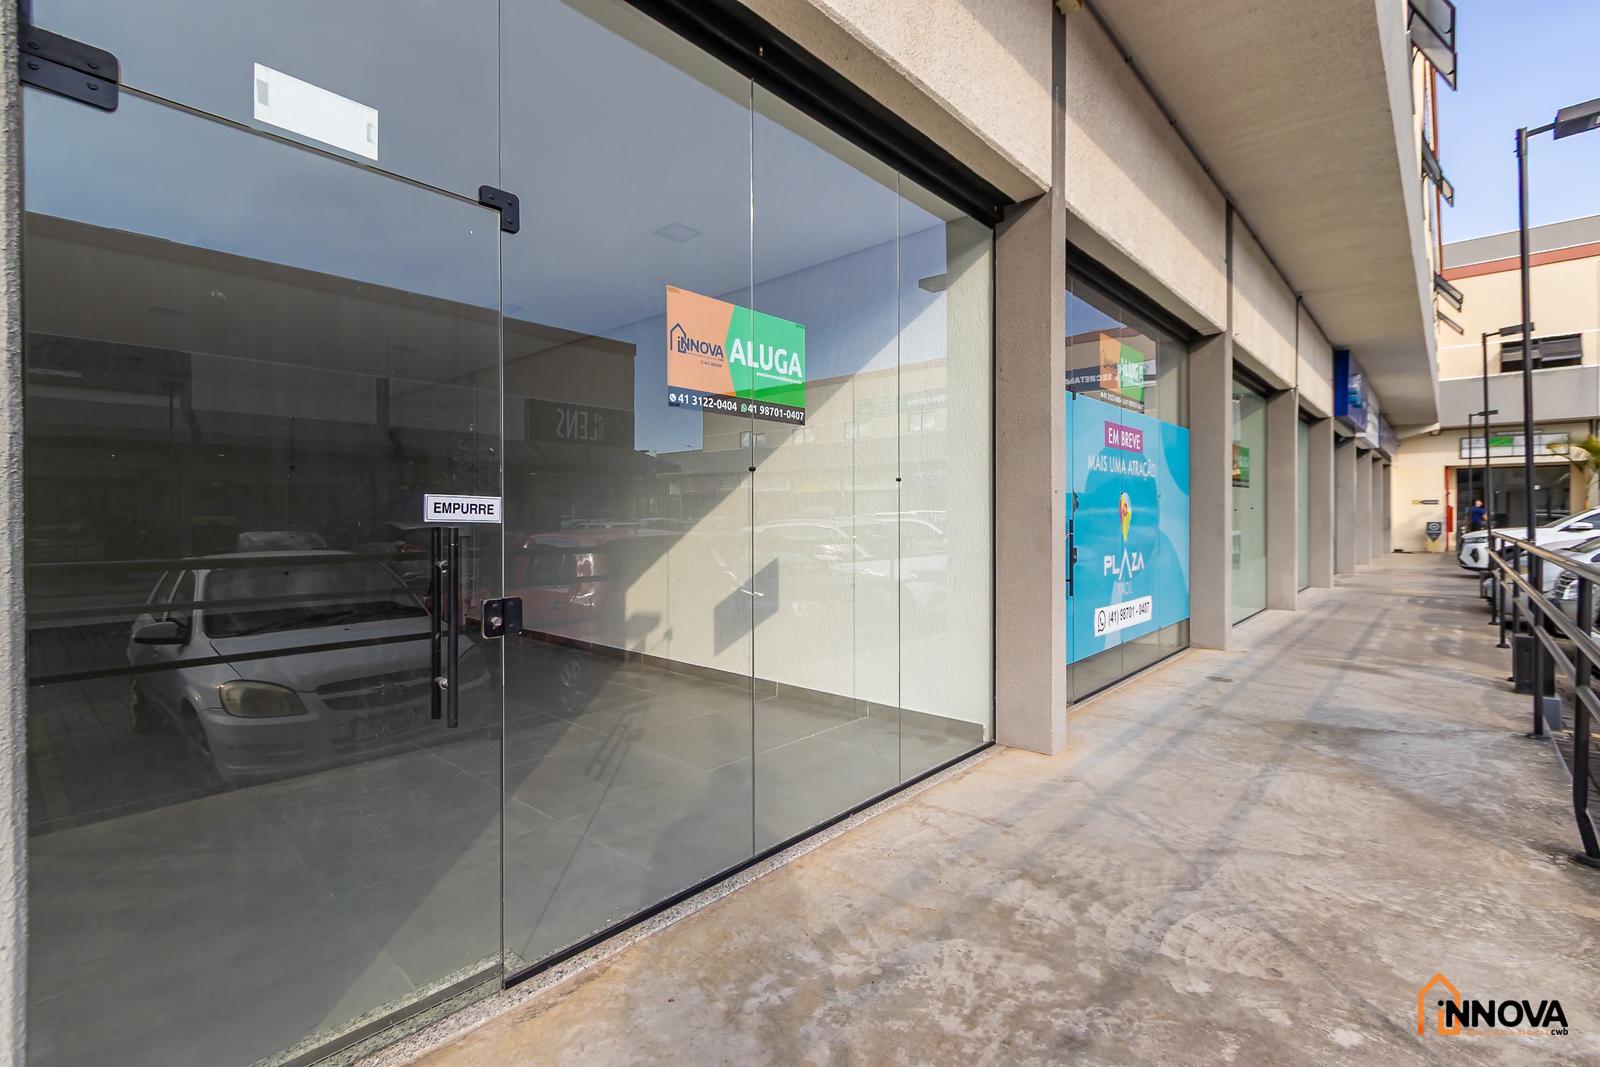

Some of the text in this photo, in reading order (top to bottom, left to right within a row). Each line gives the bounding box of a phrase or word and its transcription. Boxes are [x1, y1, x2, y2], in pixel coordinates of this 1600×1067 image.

[729, 338, 802, 377] ALUGA
[678, 394, 737, 411] 41 3122-0404
[759, 405, 804, 420] 98701-0407
[1108, 427, 1141, 449] EM BREVE
[1088, 455, 1108, 471] MAIS
[1109, 456, 1126, 474] UMA
[434, 502, 494, 515] EMPURRE
[1104, 548, 1144, 580] PLAZA
